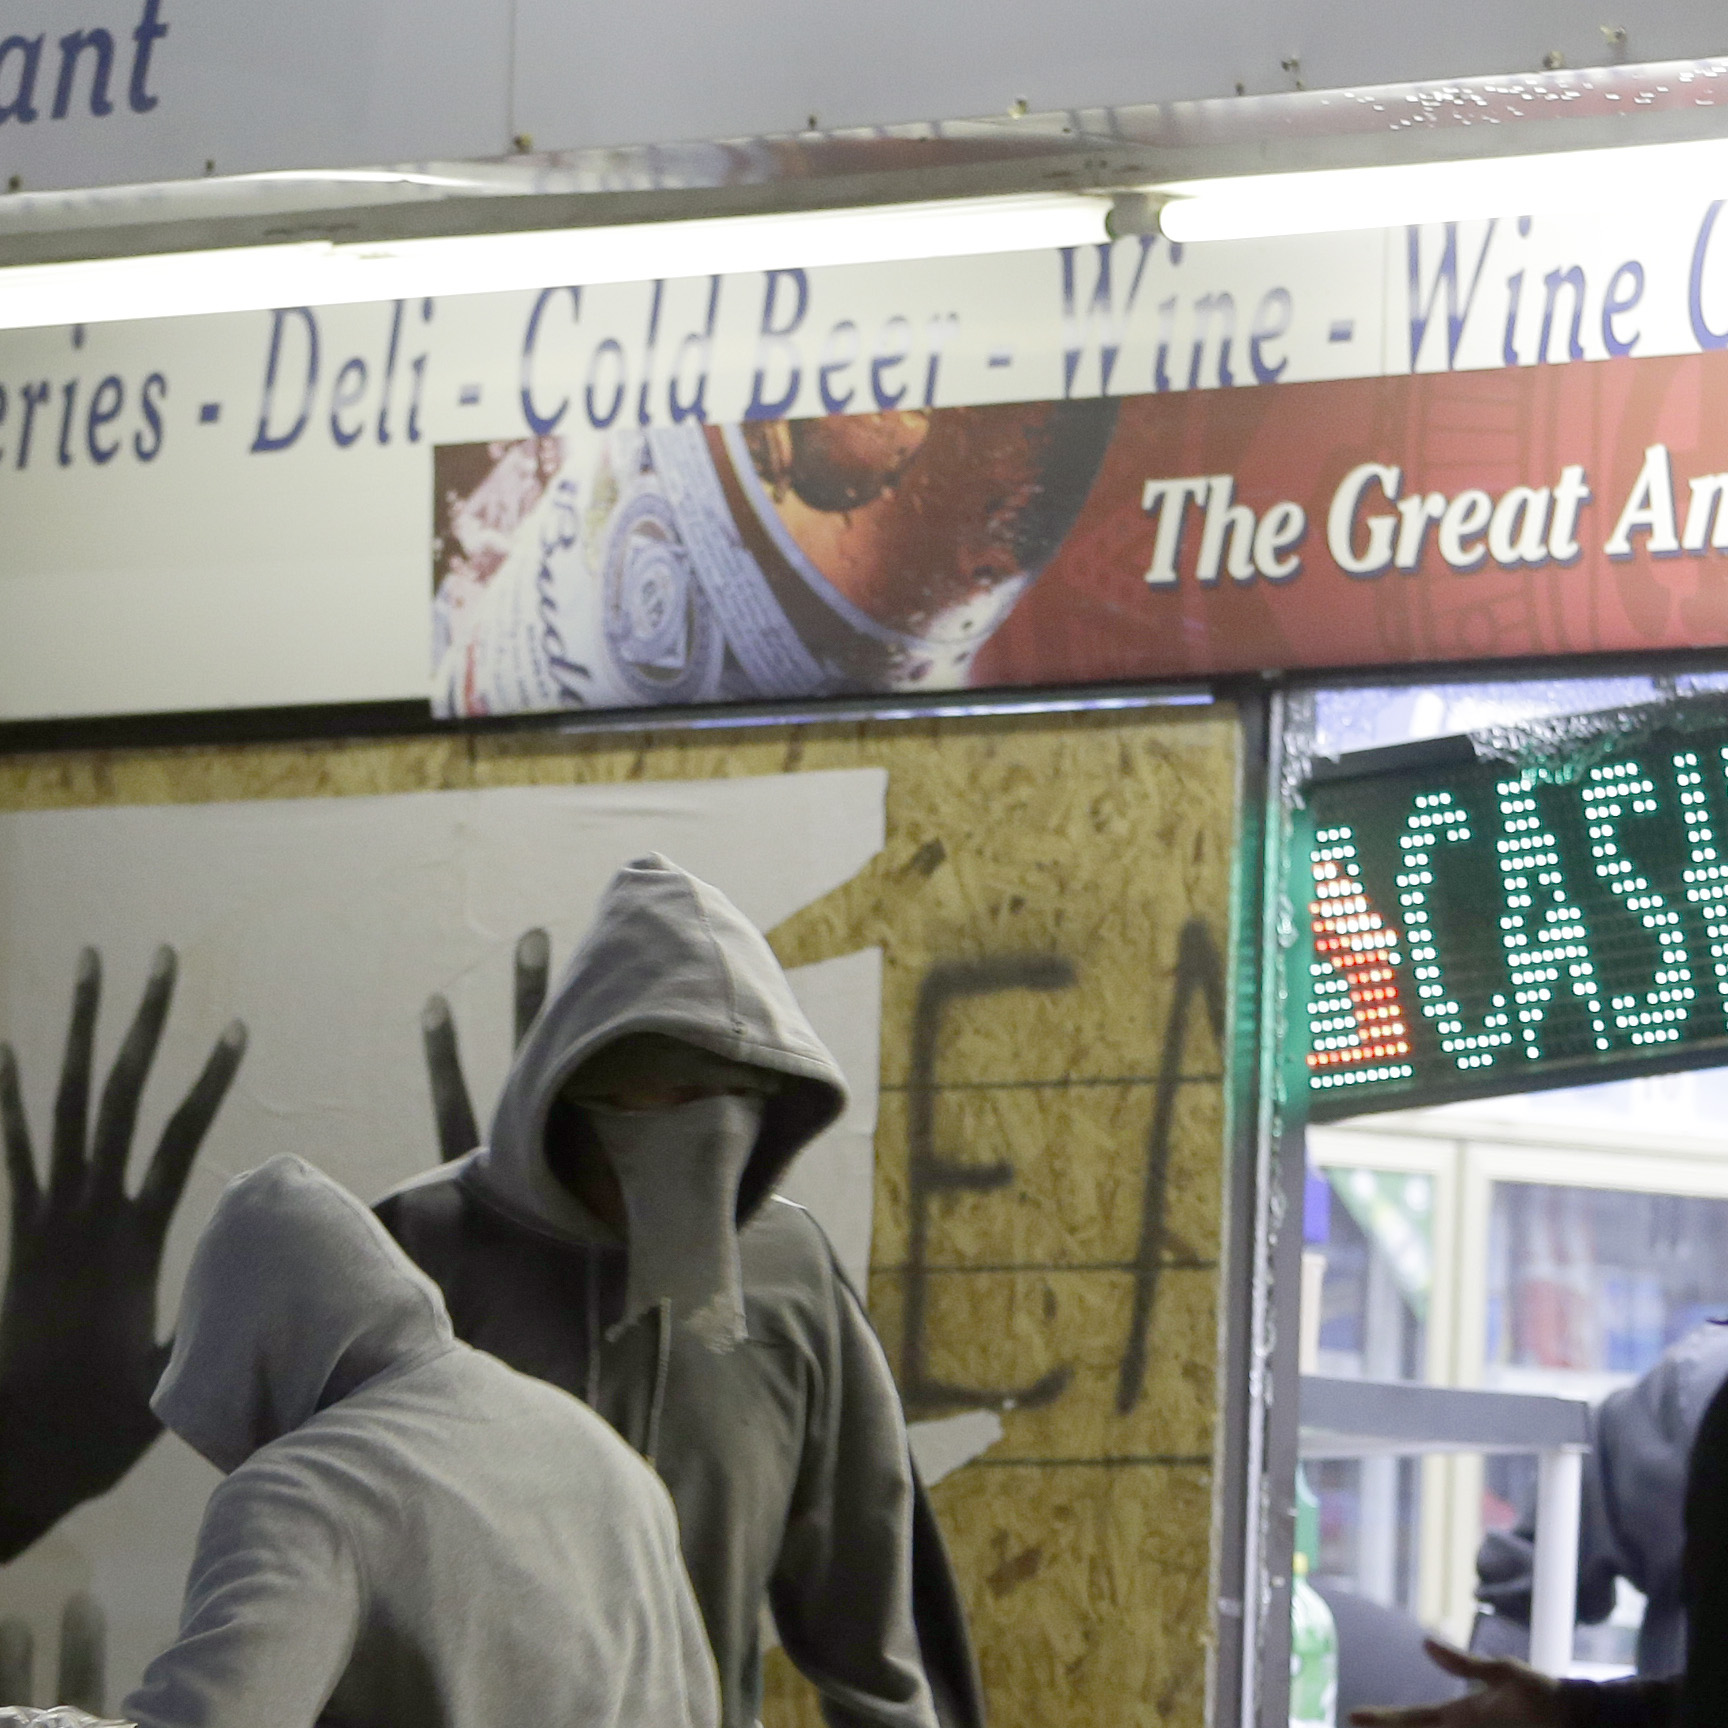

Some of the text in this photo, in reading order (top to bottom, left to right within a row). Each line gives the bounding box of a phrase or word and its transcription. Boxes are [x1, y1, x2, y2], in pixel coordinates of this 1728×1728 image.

[252, 299, 434, 452] Deli
[523, 273, 721, 435] Cold
[747, 267, 960, 420] Beer
[1062, 240, 1292, 397] Wine
[1405, 217, 1646, 374] Wine
[1142, 472, 1302, 585] The
[1327, 460, 1591, 573] Great
